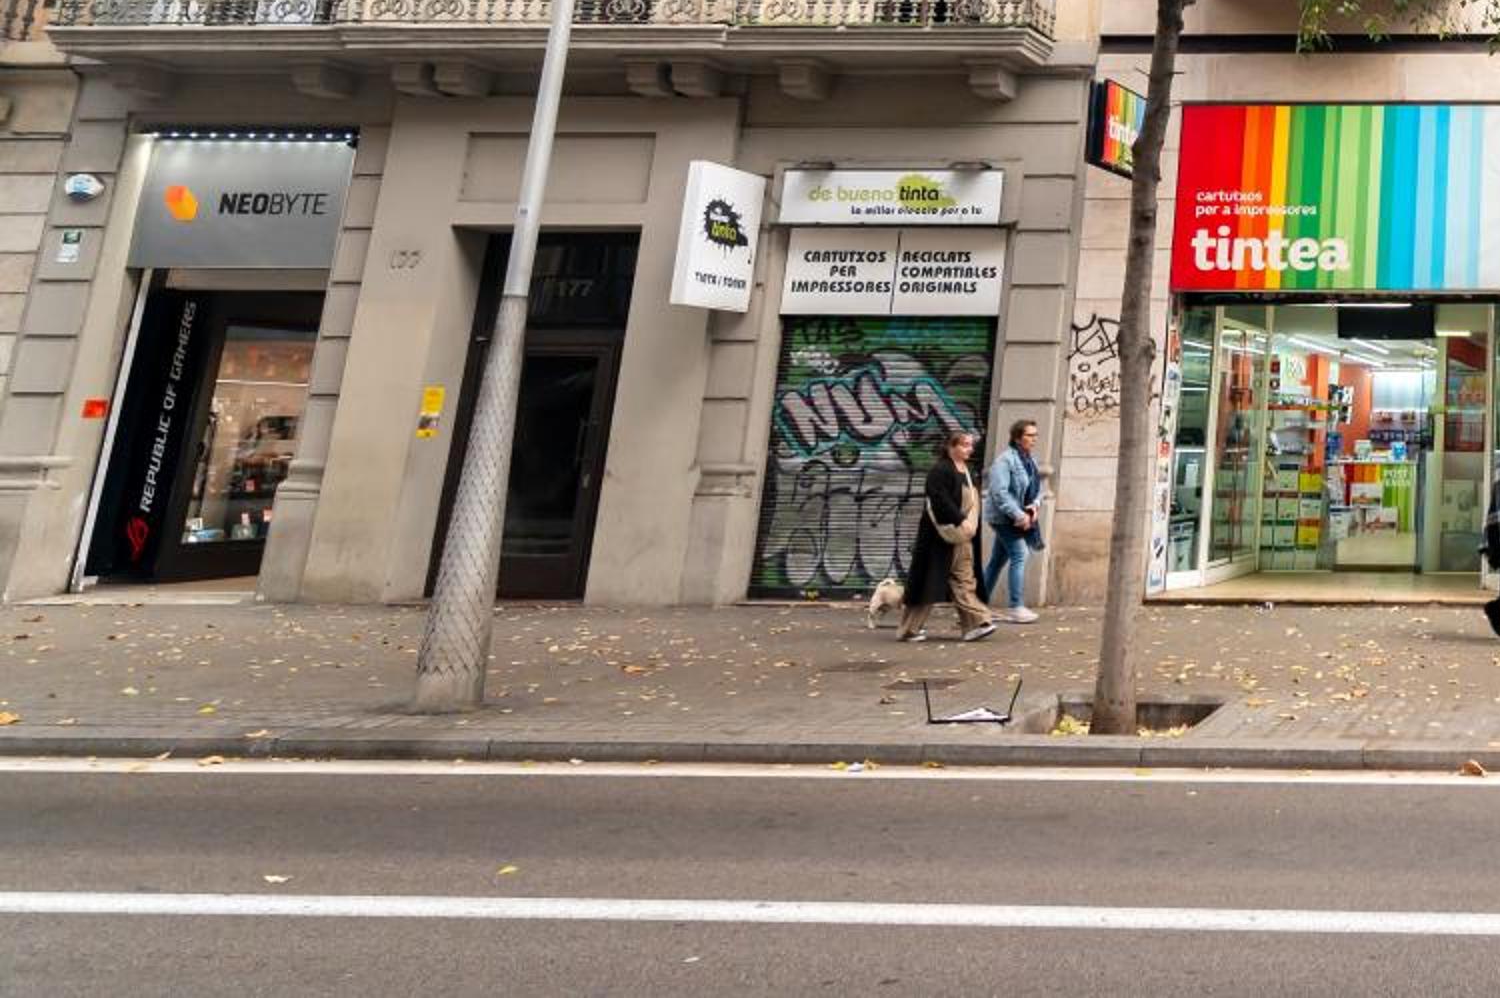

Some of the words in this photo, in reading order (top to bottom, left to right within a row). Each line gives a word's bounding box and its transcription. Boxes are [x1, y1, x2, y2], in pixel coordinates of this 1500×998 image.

[808, 185, 833, 201] de
[837, 185, 896, 201] buena
[899, 186, 940, 201] tinta
[1196, 190, 1263, 202] cartutxos
[218, 192, 329, 215] NEOBYTE
[1195, 204, 1218, 218] per
[1221, 205, 1232, 216] a
[1191, 225, 1352, 272] tintea
[803, 250, 888, 263] CARTUTXOS
[902, 250, 972, 263] RECICLATS
[829, 265, 858, 277] PER
[901, 266, 998, 279] COMPATIBLES
[791, 281, 891, 293] IMPRESSORES
[899, 281, 977, 294] ORIGINALS
[170, 301, 198, 381] GAMERS
[162, 382, 180, 411] OF
[139, 414, 172, 513] REPUBLIC
